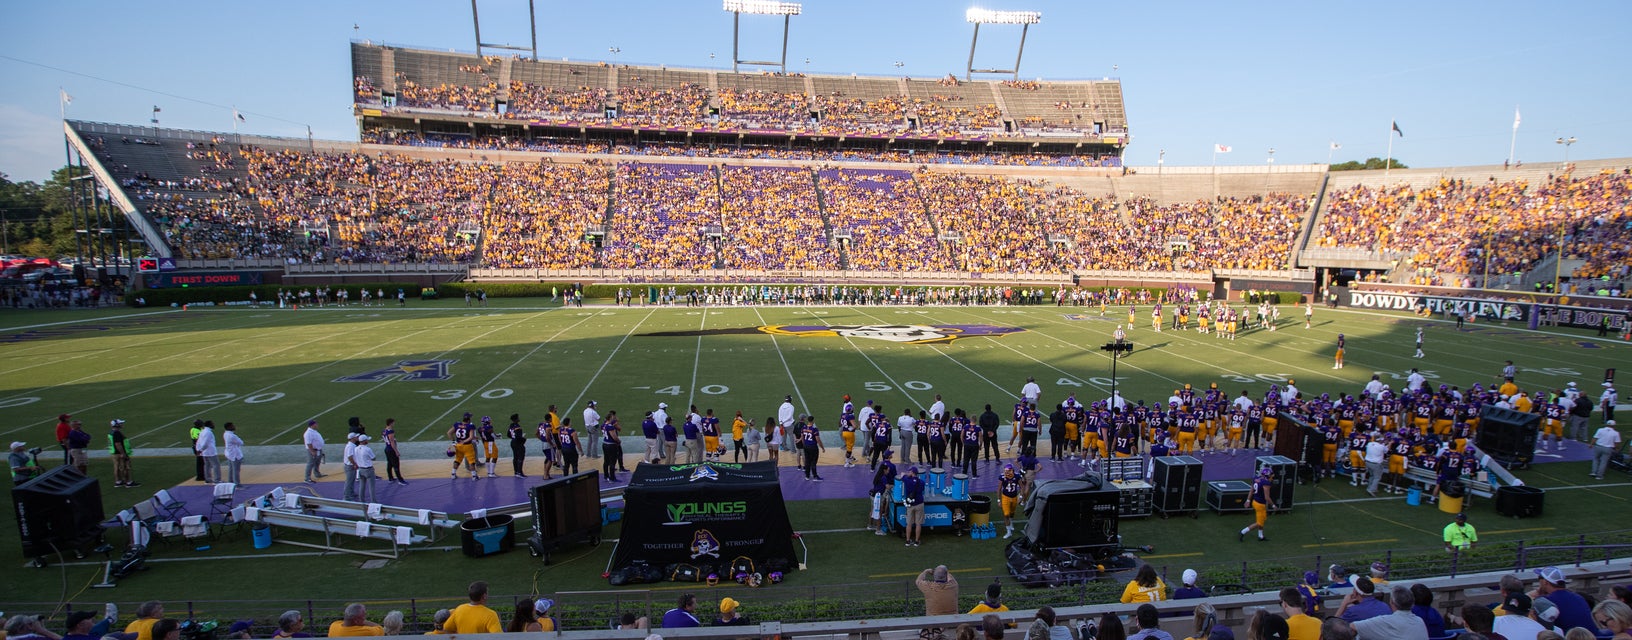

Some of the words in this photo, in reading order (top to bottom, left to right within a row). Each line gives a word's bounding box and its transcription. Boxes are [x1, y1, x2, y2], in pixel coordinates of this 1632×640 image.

[171, 275, 202, 284] FIRST
[205, 274, 241, 284] DOWN!
[655, 385, 729, 396] 40
[864, 380, 933, 392] 50
[183, 392, 286, 405] 20
[430, 388, 514, 400] 30
[1250, 410, 1260, 418] 82
[1265, 407, 1276, 416] 96
[1343, 410, 1354, 418] 66
[1417, 406, 1430, 416] 92
[1547, 409, 1559, 417] 56
[1026, 417, 1037, 426] 50
[1127, 416, 1136, 425] 51
[1151, 417, 1162, 426] 65
[1183, 419, 1195, 428] 60
[703, 423, 713, 432] 54
[876, 426, 886, 437] 42
[917, 425, 927, 434] 28
[931, 426, 940, 437] 95
[952, 423, 963, 432] 48
[456, 429, 467, 439] 63
[560, 434, 571, 444] 78
[803, 432, 813, 441] 72
[965, 431, 977, 441] 56
[1325, 431, 1338, 441] 94
[1117, 437, 1127, 448] 57
[1353, 438, 1367, 448] 97
[1396, 443, 1409, 454] 45
[1448, 457, 1459, 468] 12
[666, 501, 747, 523] YOUNGS
[900, 512, 949, 521] PRADE
[643, 542, 684, 550] TOGETHER
[725, 538, 765, 547] STRONGER
